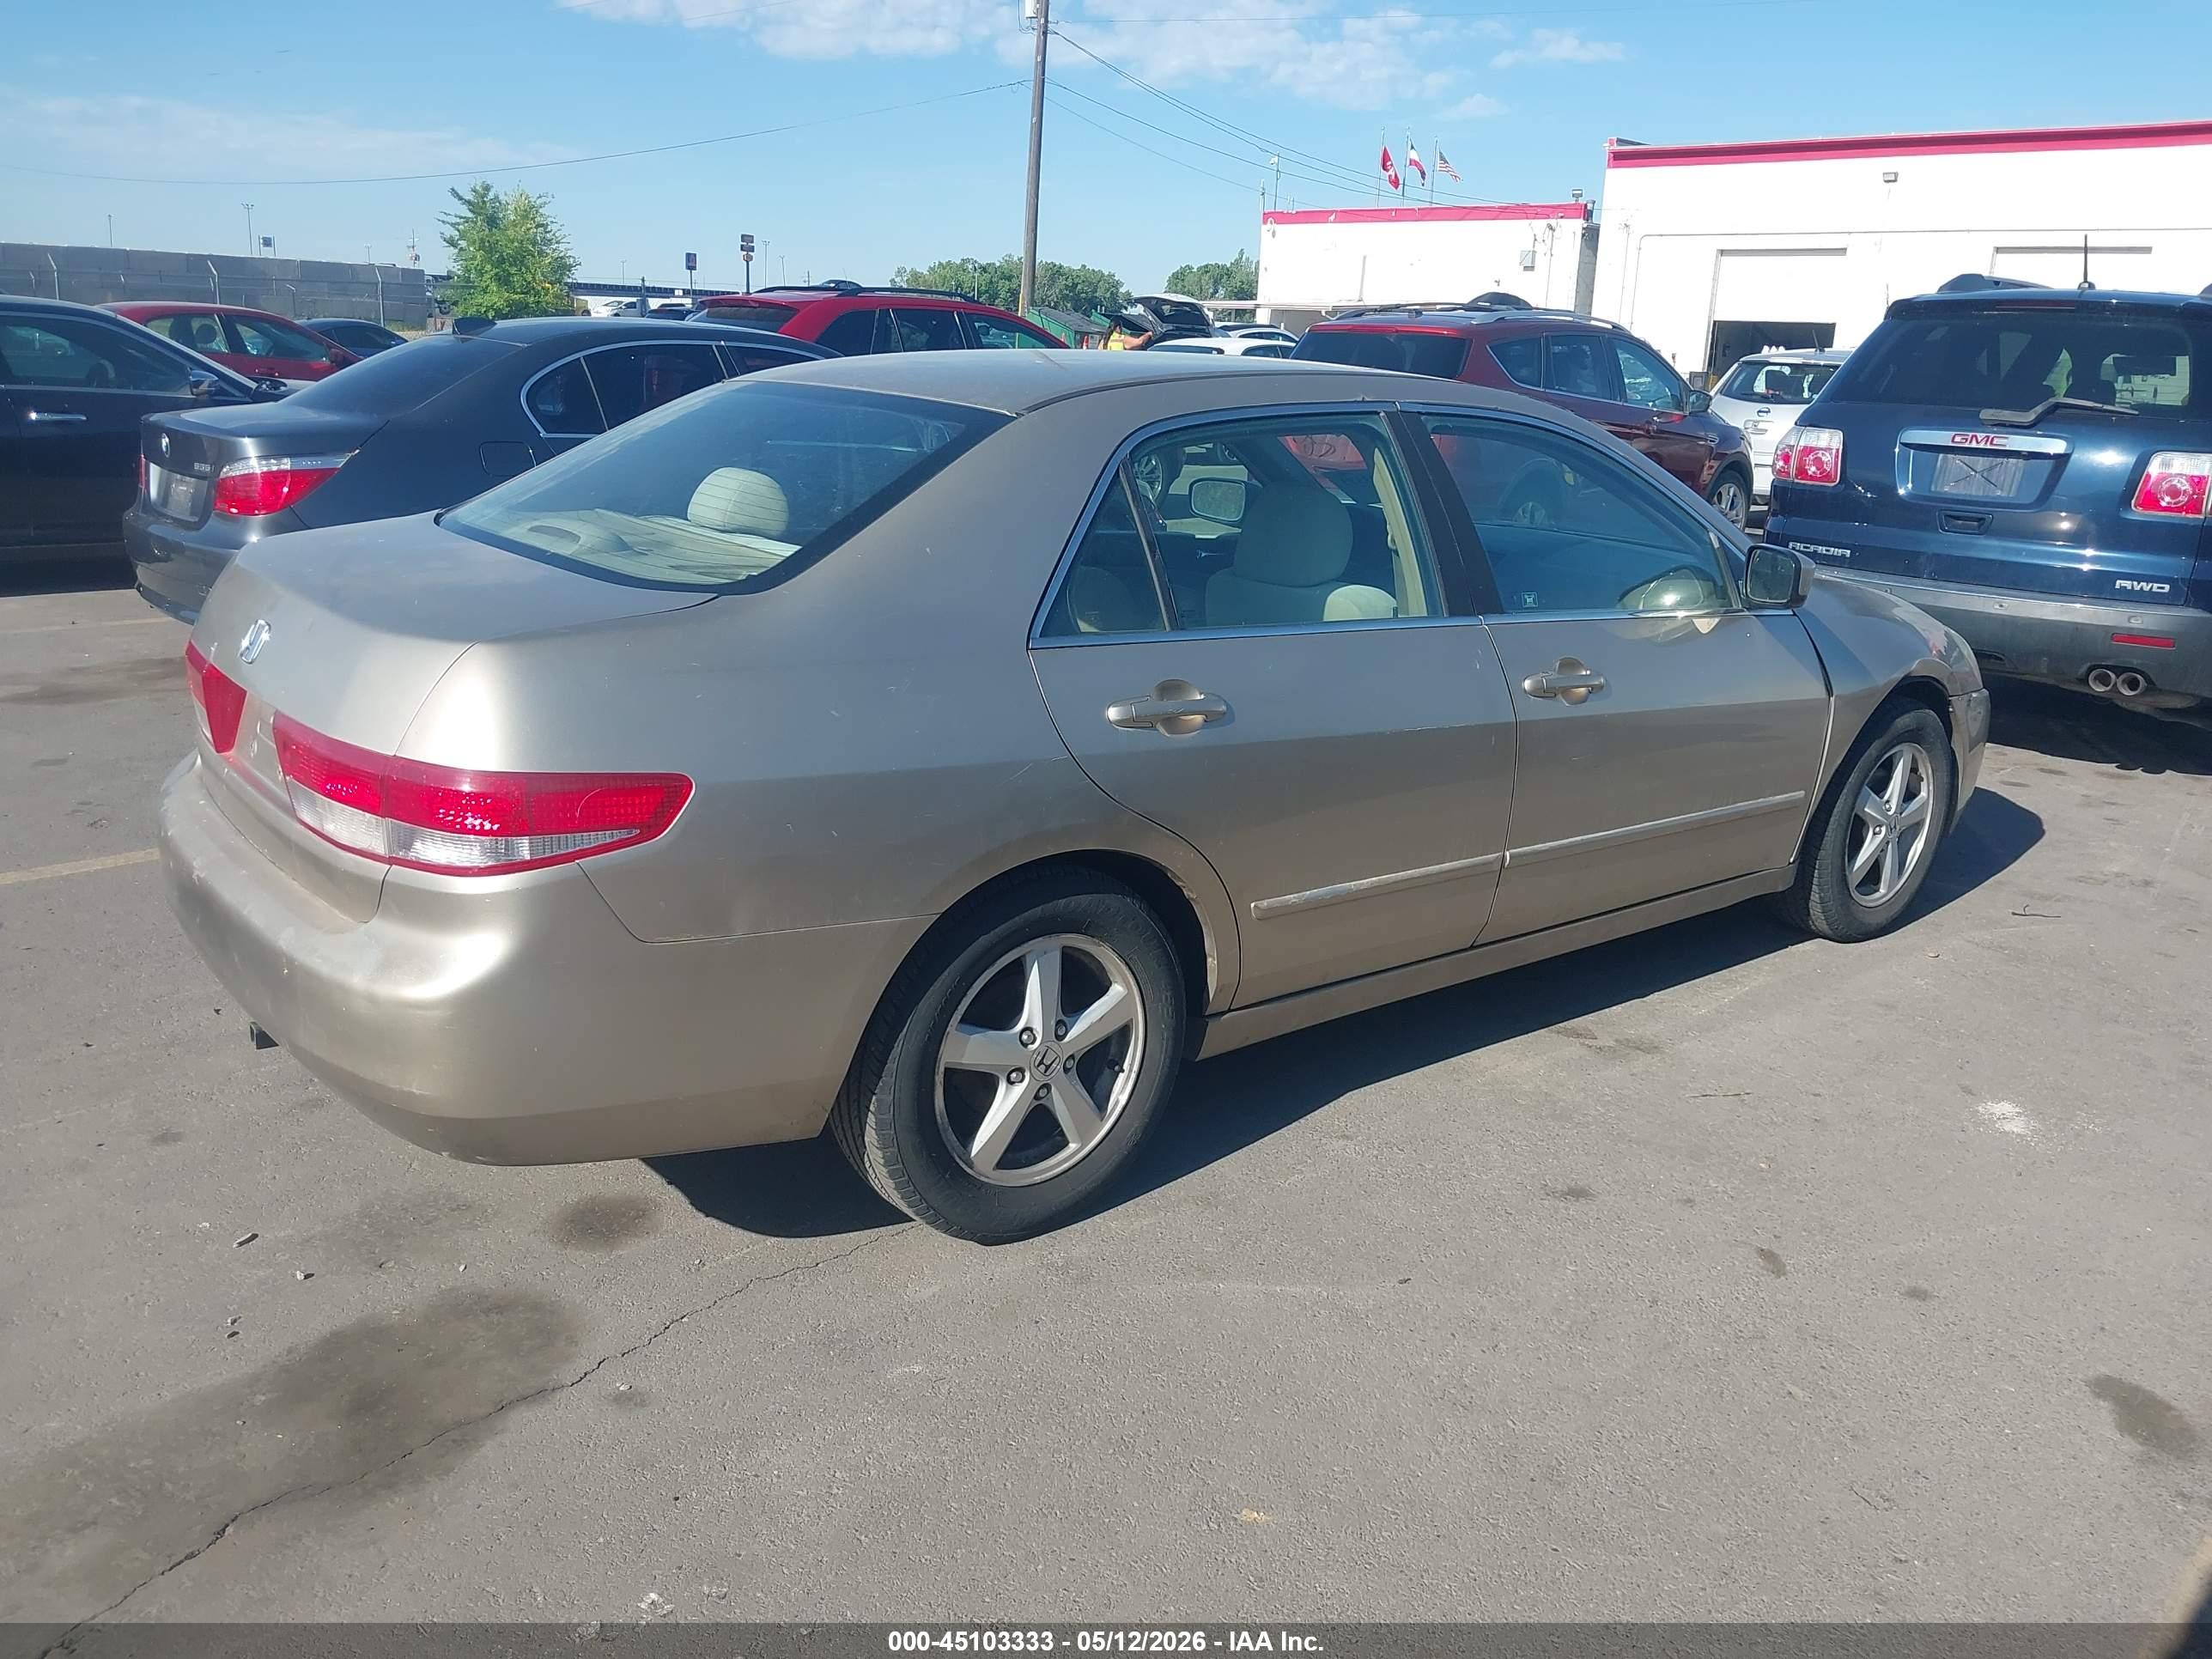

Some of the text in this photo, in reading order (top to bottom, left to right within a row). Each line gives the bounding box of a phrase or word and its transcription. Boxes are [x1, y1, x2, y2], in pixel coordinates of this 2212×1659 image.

[1950, 433, 2008, 447] GMC
[1788, 541, 1850, 557] ACADIA
[2115, 579, 2170, 592] AWD
